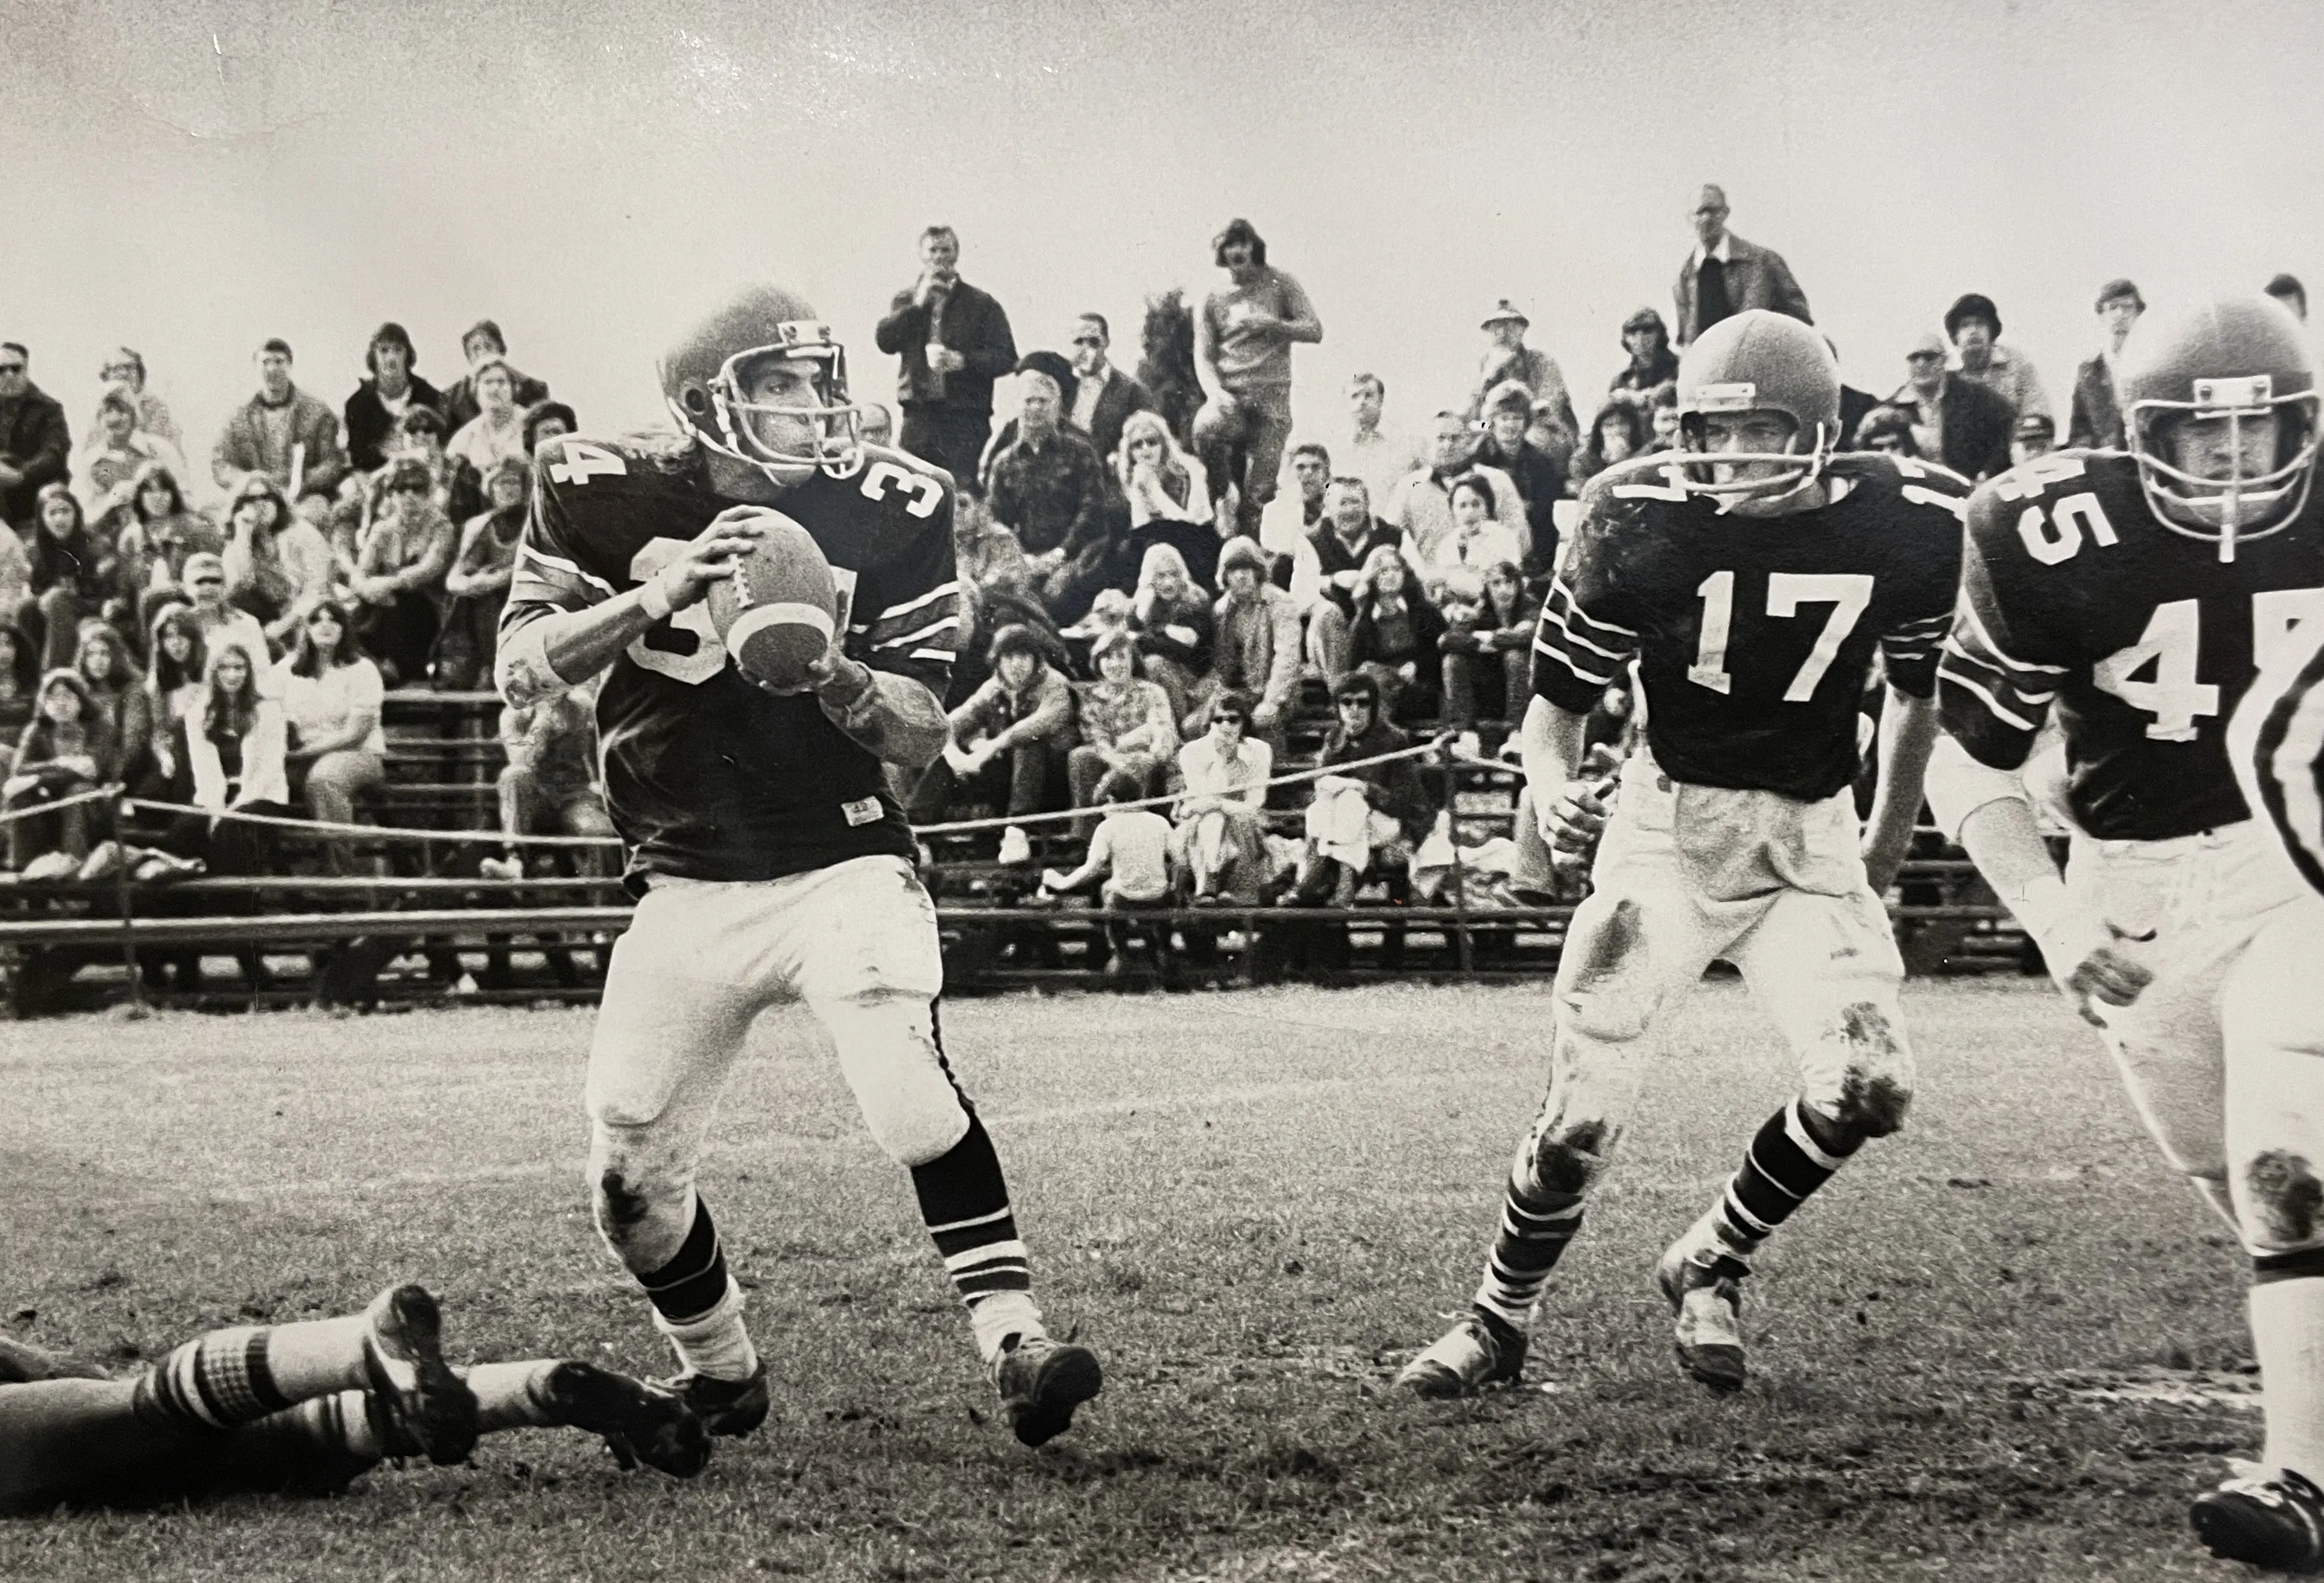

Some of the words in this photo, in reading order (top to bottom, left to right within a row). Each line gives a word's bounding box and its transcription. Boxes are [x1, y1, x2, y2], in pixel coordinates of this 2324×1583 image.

[550, 441, 627, 485] 4
[860, 462, 944, 518] 3
[1687, 571, 1875, 702] 17
